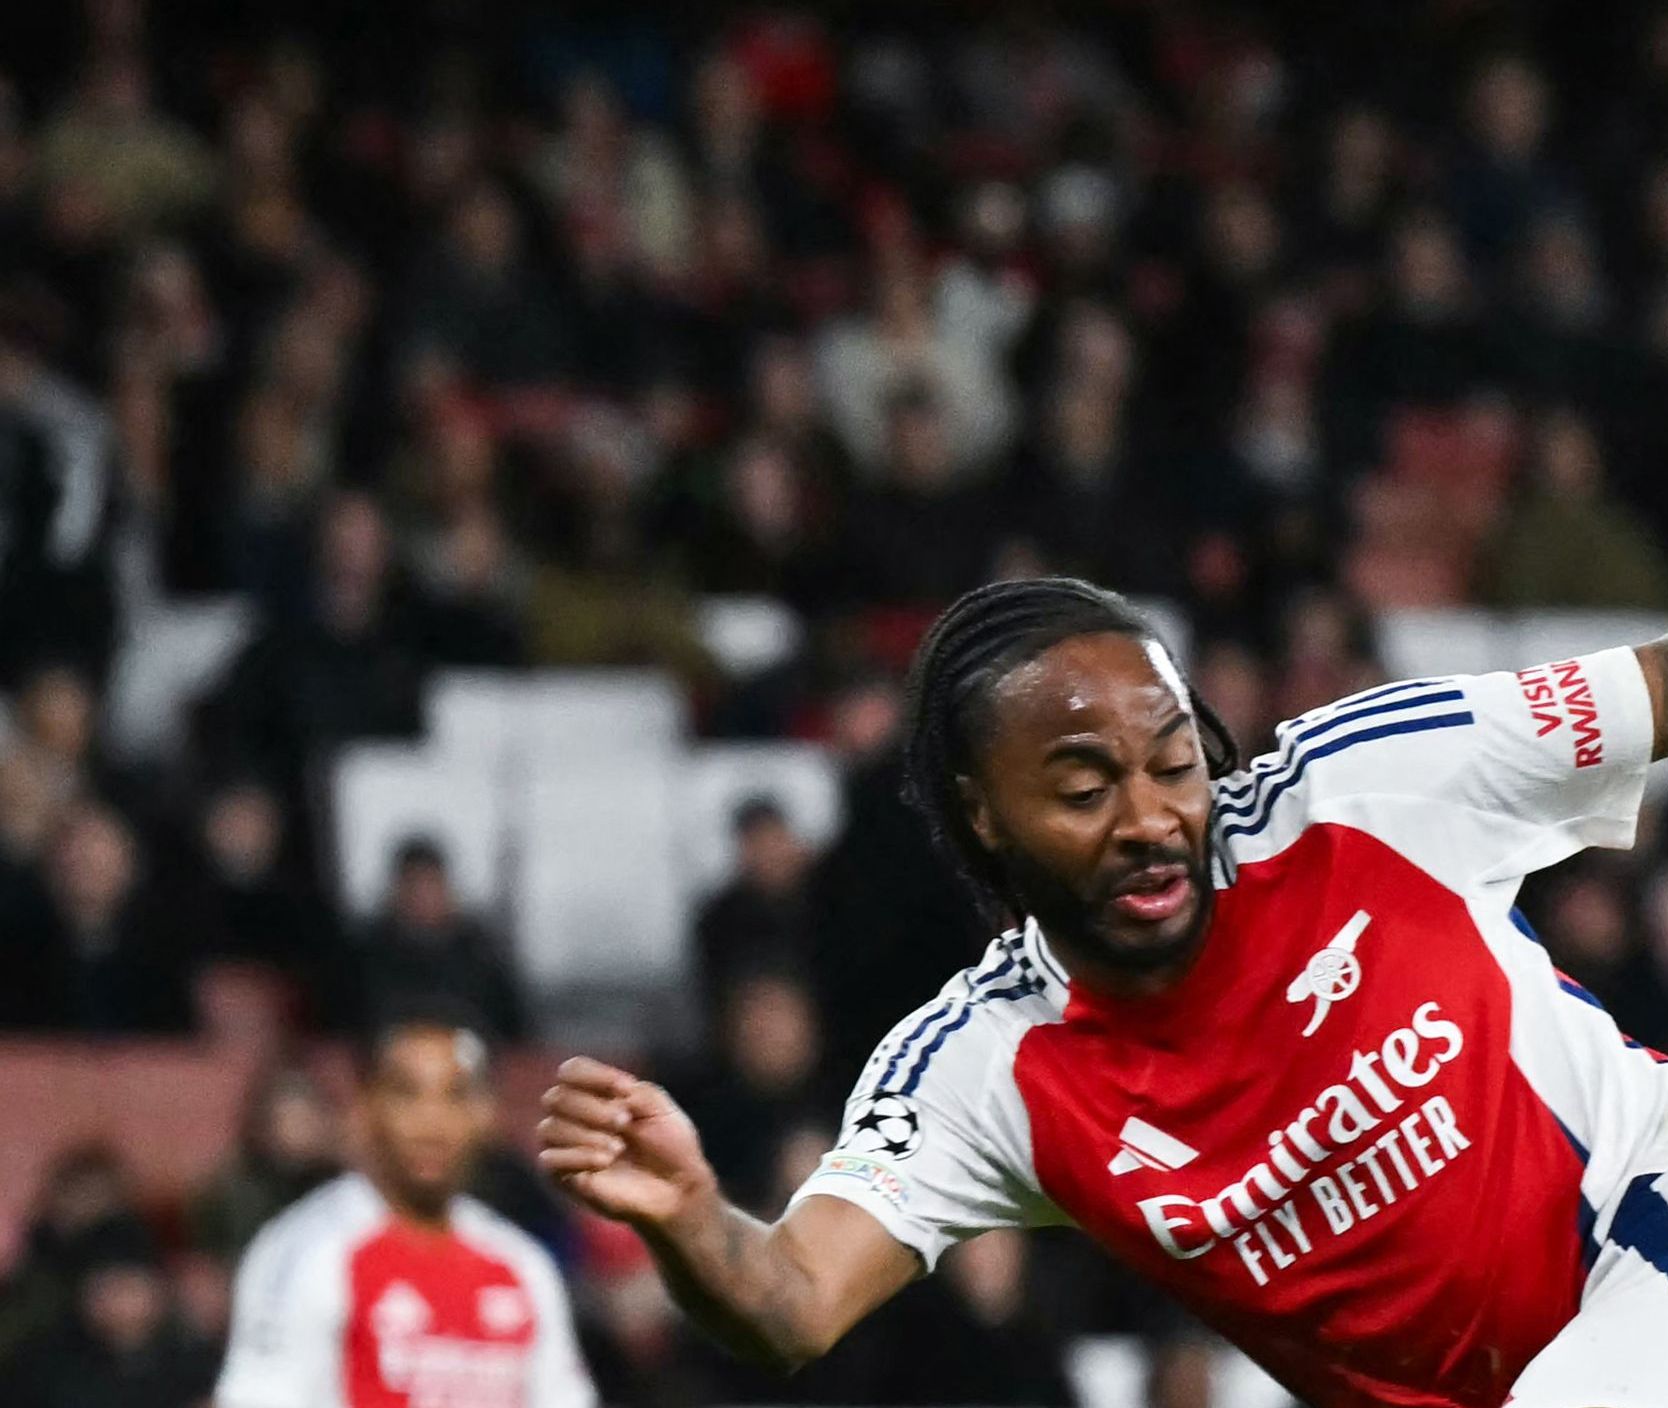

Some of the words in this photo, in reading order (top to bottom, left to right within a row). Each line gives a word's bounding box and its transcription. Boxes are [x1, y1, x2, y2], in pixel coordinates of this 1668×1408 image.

[1136, 1001, 1465, 1261] Emirates
[1233, 1200, 1312, 1287] FLY
[1310, 1095, 1472, 1236] BETTER
